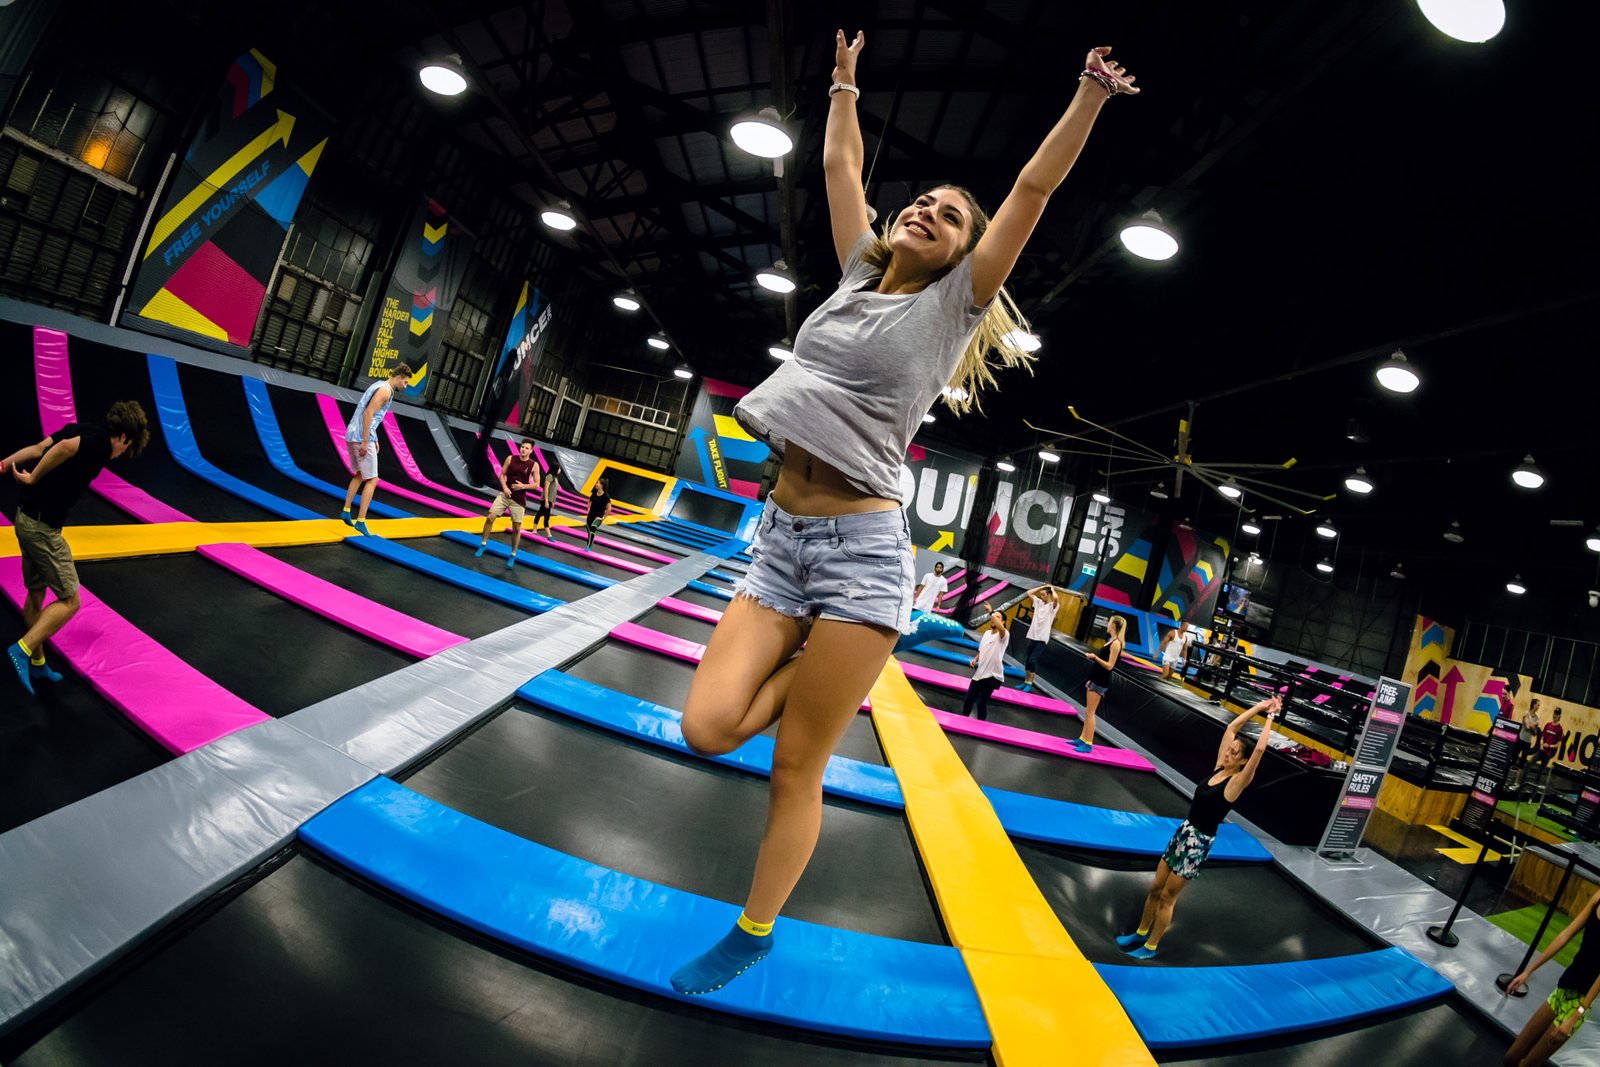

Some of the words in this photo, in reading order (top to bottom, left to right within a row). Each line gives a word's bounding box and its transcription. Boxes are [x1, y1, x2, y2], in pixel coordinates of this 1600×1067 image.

[163, 222, 202, 266] FREE
[201, 160, 270, 226] YOURSELF
[386, 297, 399, 309] THE
[383, 308, 410, 322] HARDER
[381, 318, 395, 329] YOU
[378, 327, 393, 339] FALL
[376, 337, 390, 348] THE
[373, 347, 399, 359] HIGHER
[371, 358, 385, 368] YOU
[368, 367, 393, 378] BOUNC
[708, 438, 719, 460] TAKE
[713, 459, 727, 489] FLIGHT
[1377, 693, 1396, 706] JUMP
[1352, 772, 1378, 785] SAFETY
[1477, 775, 1497, 788] SAFETY
[1348, 782, 1371, 794] RULES
